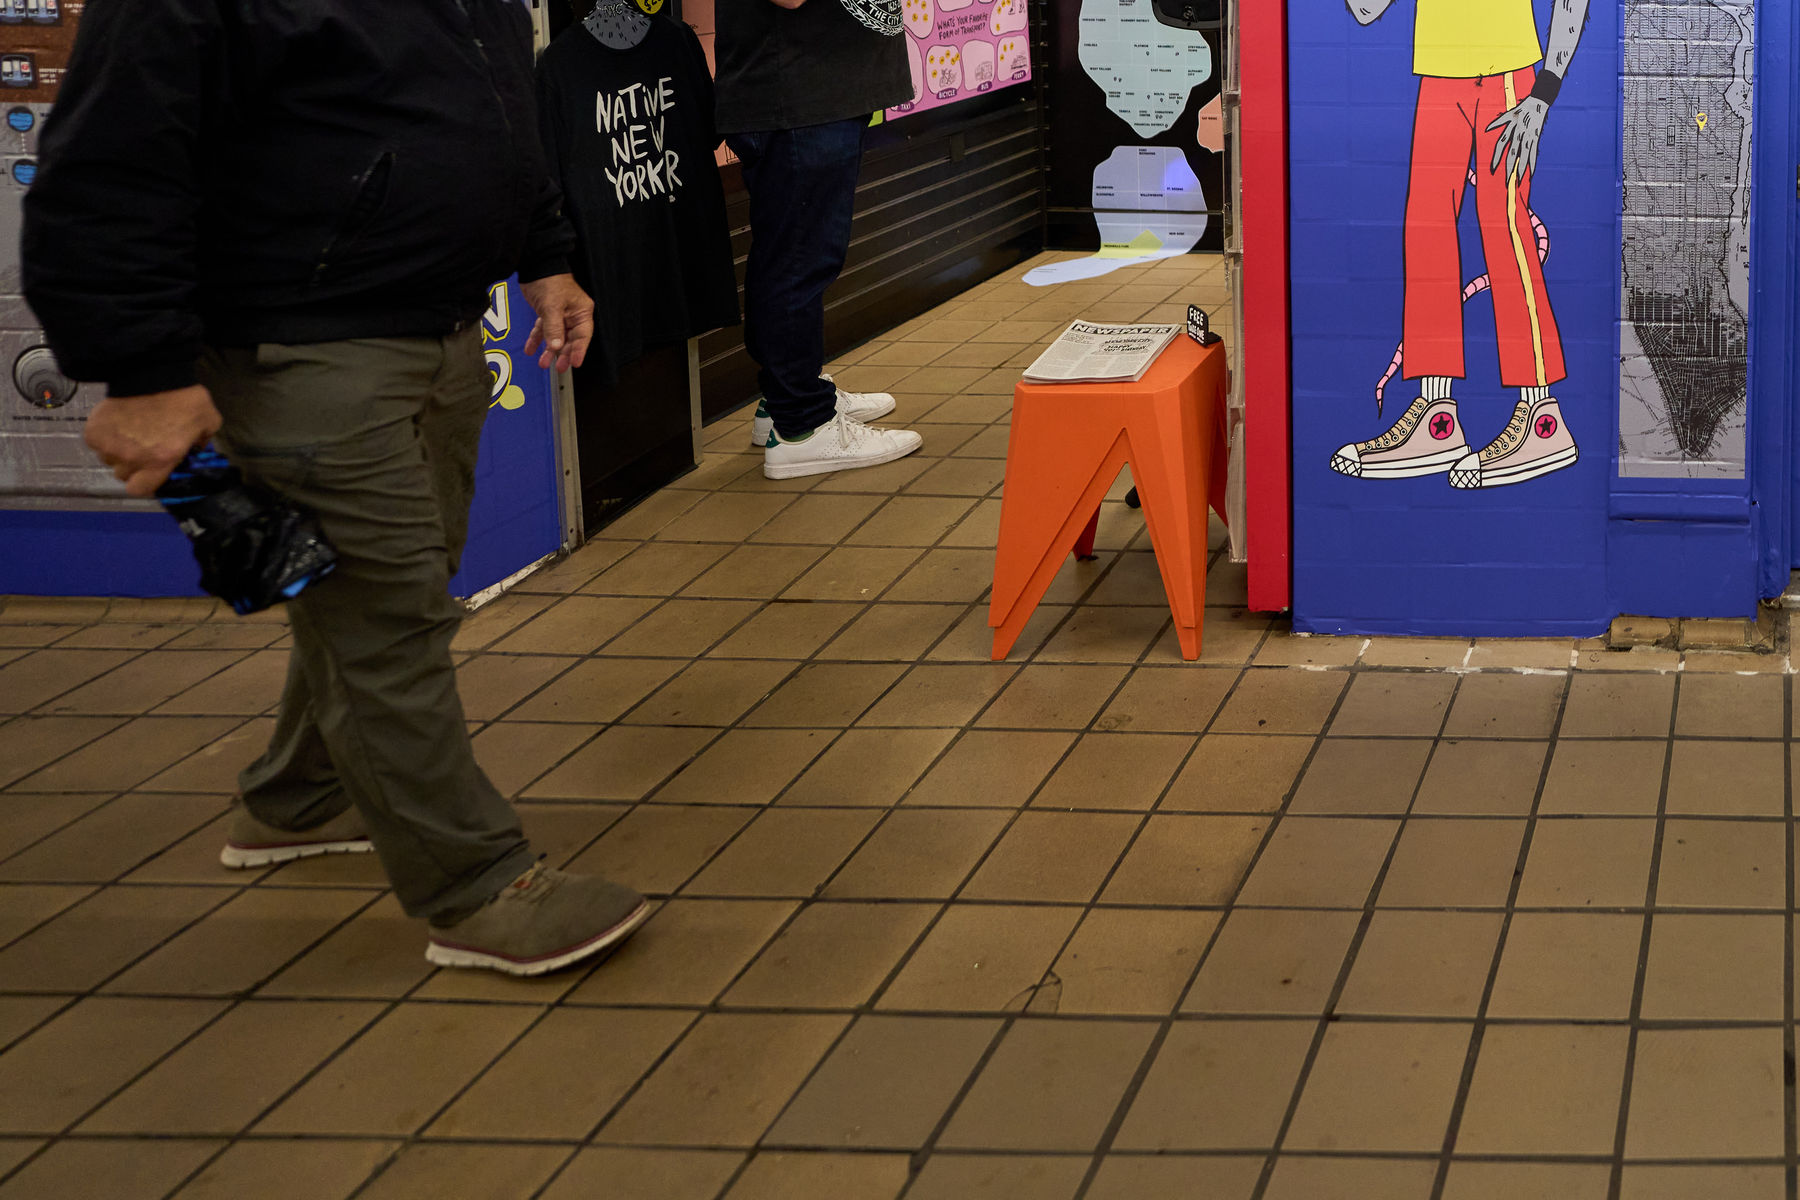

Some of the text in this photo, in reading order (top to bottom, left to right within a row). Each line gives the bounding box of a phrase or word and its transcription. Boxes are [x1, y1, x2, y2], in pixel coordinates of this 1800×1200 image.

[596, 76, 676, 134] NATIVE
[1189, 306, 1204, 326] FREE
[1073, 323, 1174, 335] NEWSPAPER
